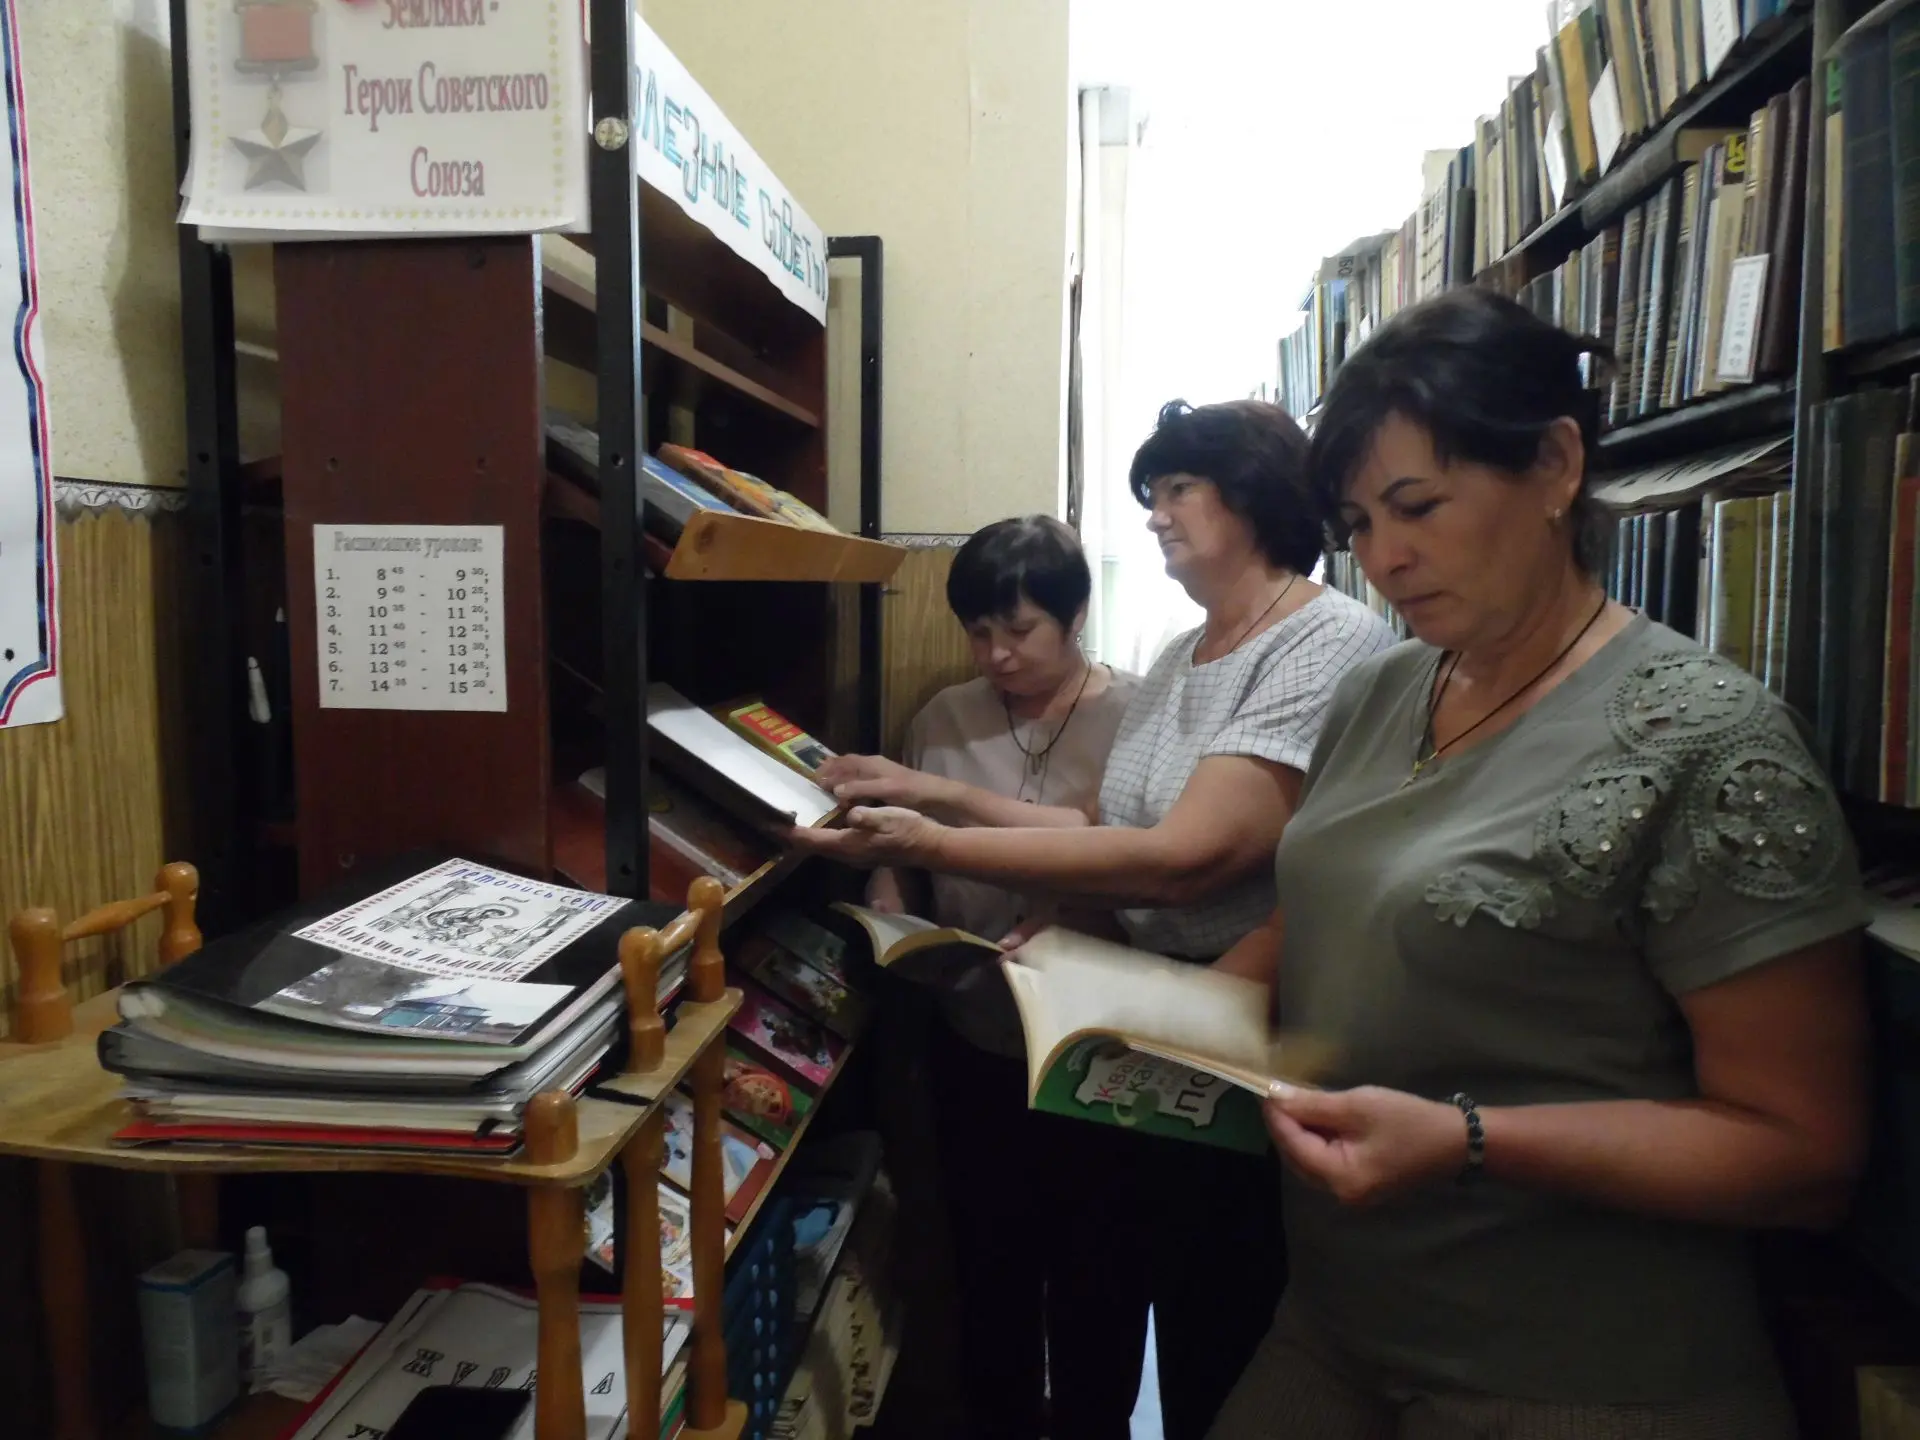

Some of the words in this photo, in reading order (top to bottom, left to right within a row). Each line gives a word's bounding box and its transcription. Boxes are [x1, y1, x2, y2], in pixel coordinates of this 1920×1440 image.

[343, 64, 413, 132] Герои
[417, 61, 549, 114] Советского
[410, 146, 485, 198] Союза
[326, 568, 340, 580] 1.
[456, 569, 466, 581] 9
[326, 587, 341, 599] 2.
[447, 588, 466, 600] 10
[327, 605, 341, 617] 3.
[368, 606, 388, 618] 10
[447, 607, 466, 619] 11
[327, 624, 342, 636] 4.
[368, 624, 388, 636] 11
[448, 626, 467, 638] 12
[328, 642, 342, 654] 5.
[369, 643, 389, 655] 12
[448, 644, 467, 656] 13
[328, 661, 343, 673] 6.
[369, 661, 389, 673] 13
[448, 663, 468, 675] 14
[329, 679, 343, 691] 7.
[370, 680, 390, 692] 14
[449, 681, 468, 693] 15
